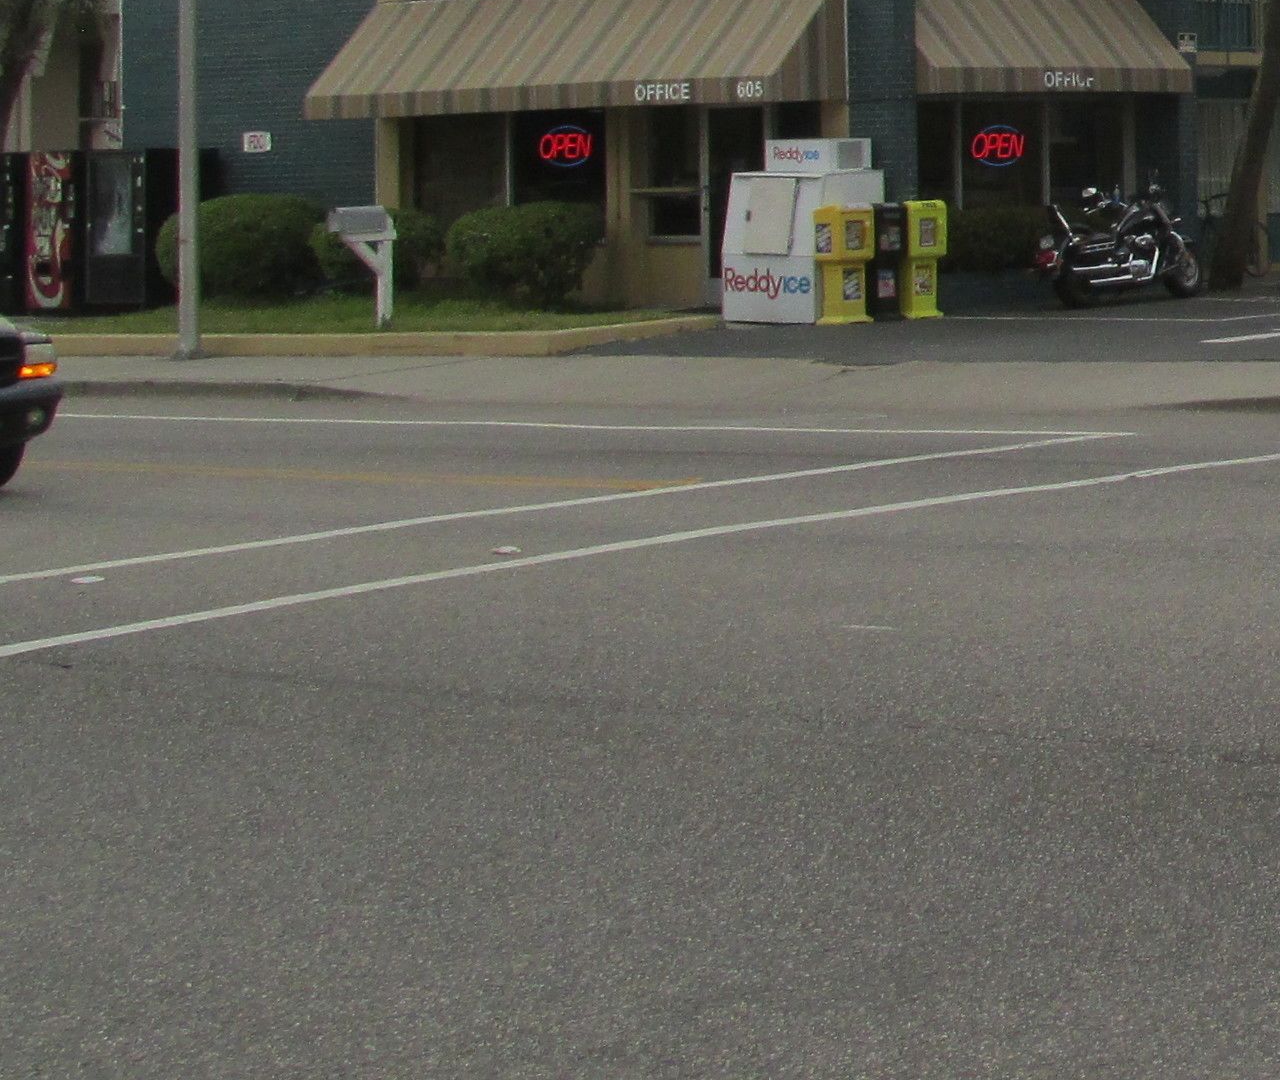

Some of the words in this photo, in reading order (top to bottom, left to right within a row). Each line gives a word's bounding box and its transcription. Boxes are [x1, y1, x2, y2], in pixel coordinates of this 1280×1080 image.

[634, 82, 691, 101] OFFICE
[736, 80, 763, 98] 605
[539, 133, 591, 159] OPEN
[972, 133, 1024, 158] OPEN
